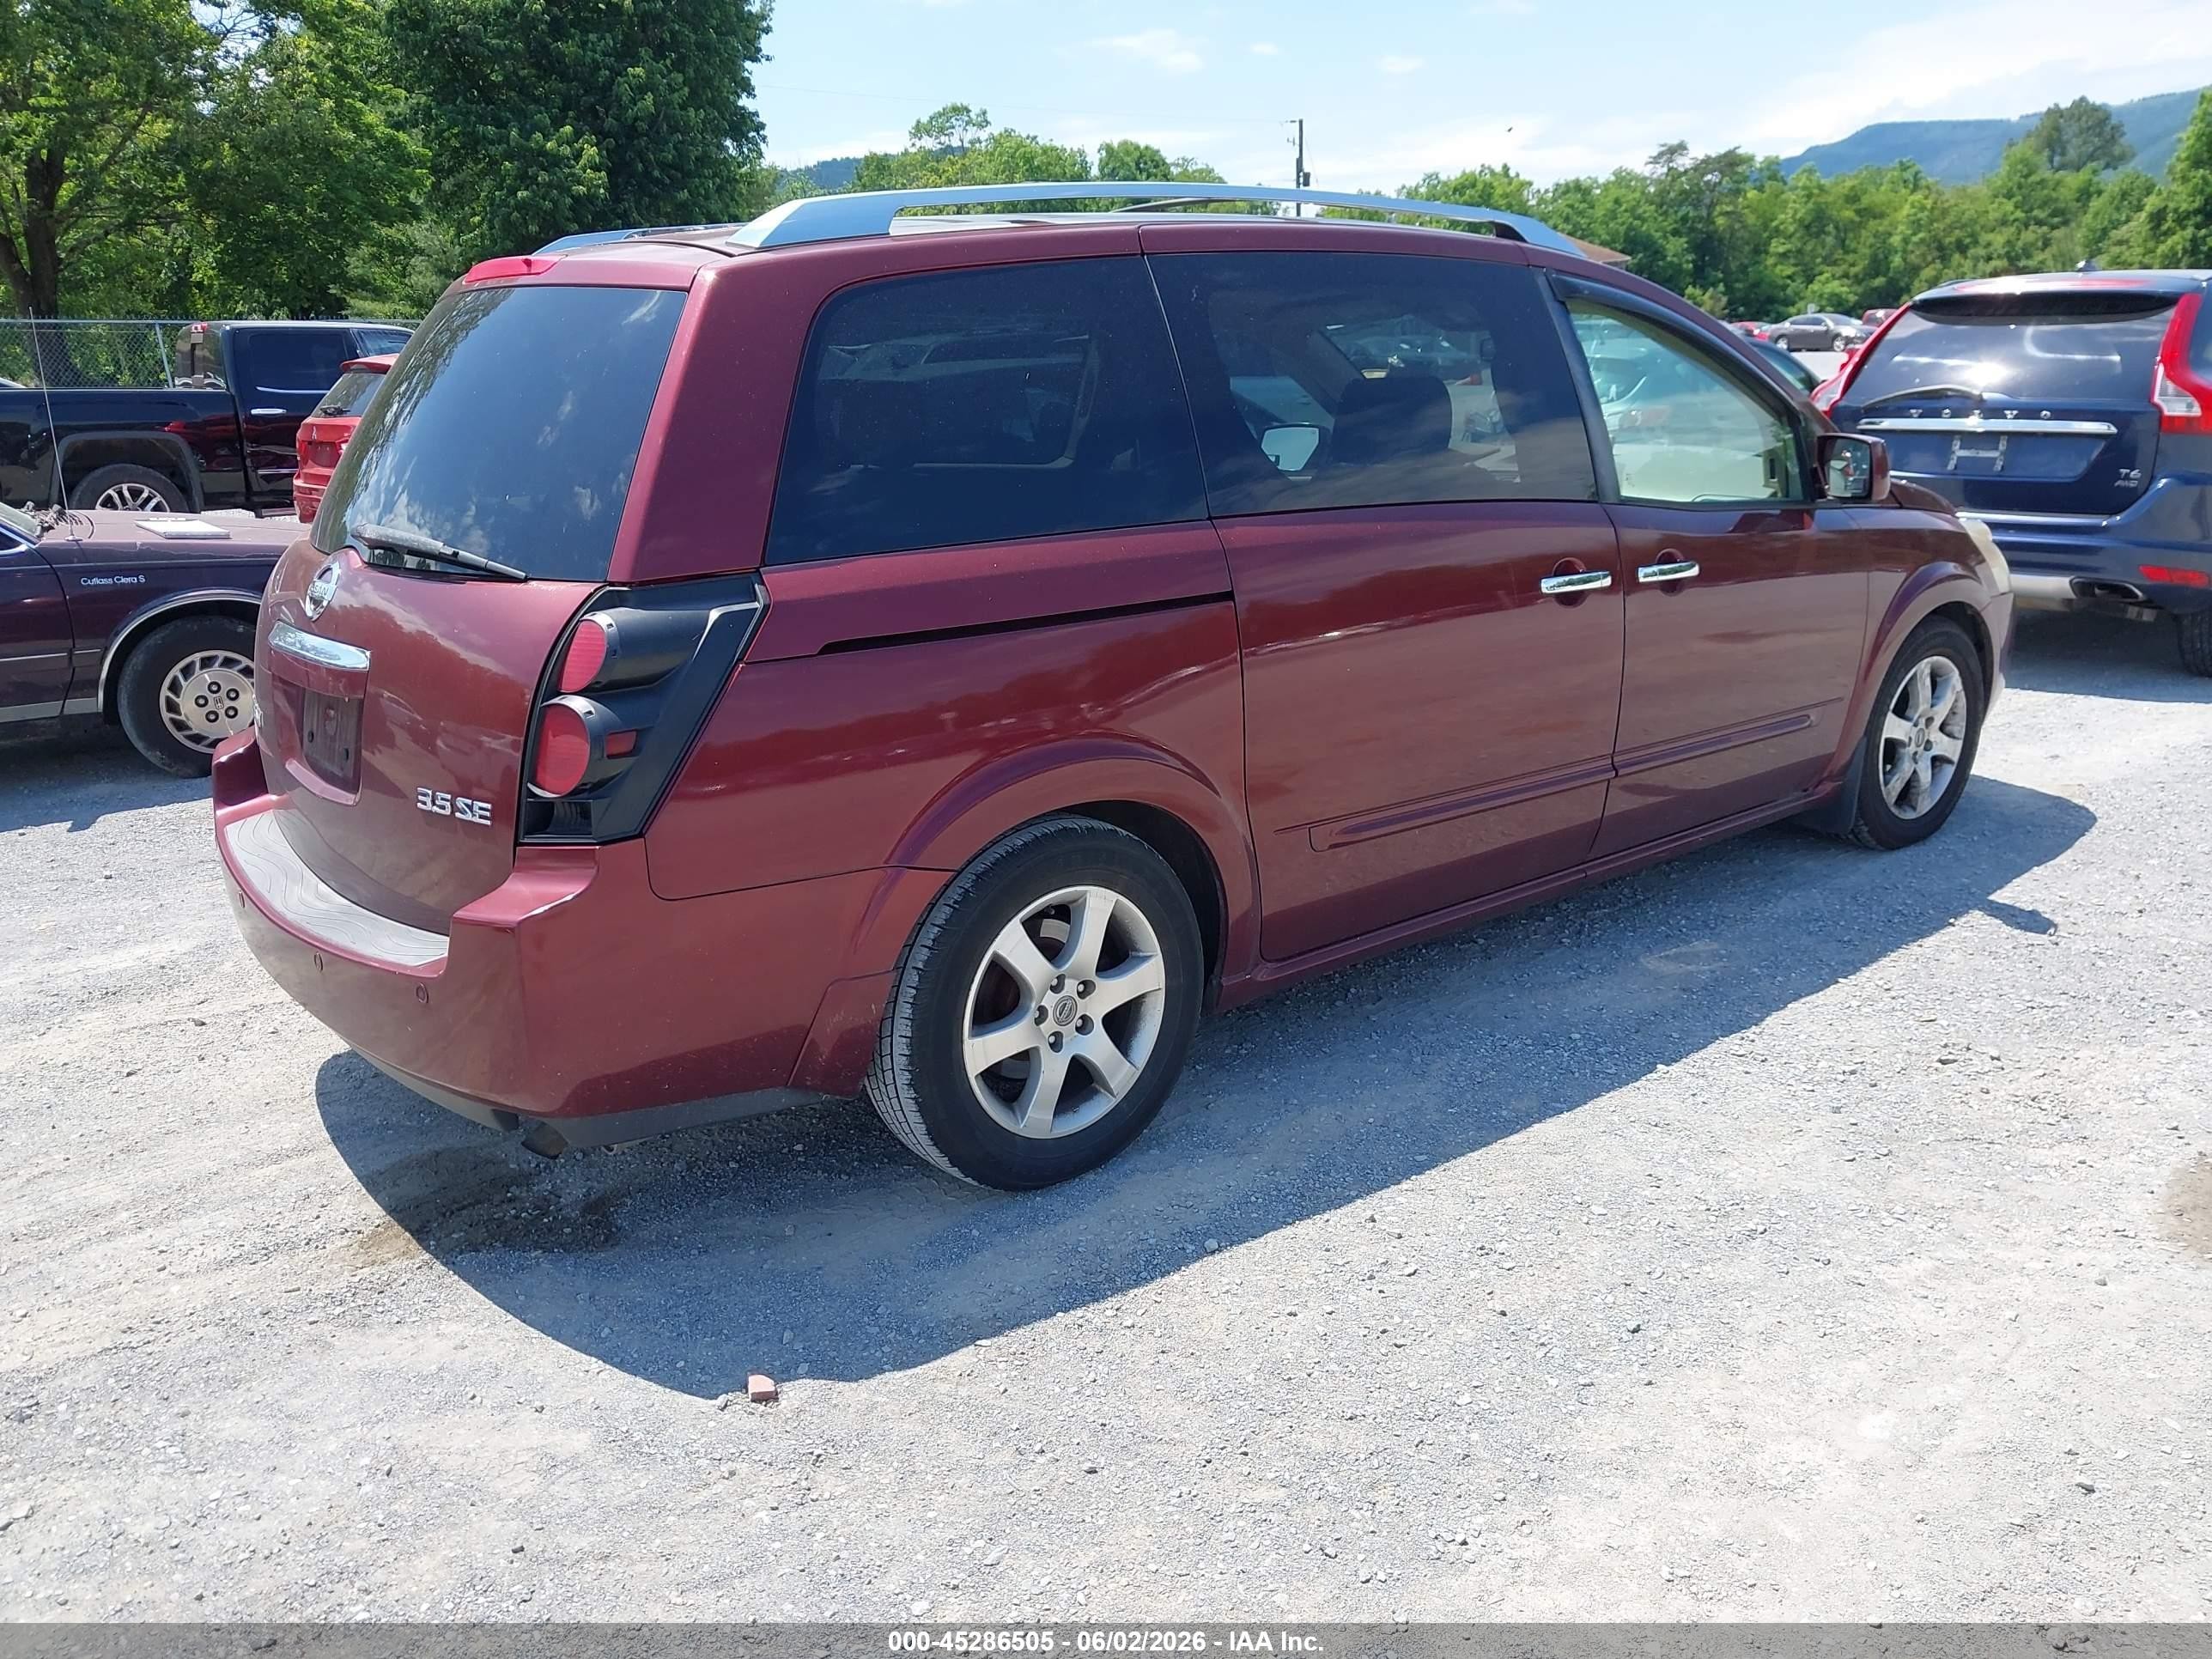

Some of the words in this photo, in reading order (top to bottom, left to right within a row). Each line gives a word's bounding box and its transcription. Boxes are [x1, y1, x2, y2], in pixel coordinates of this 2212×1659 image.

[1909, 408, 2051, 419] VOLVO
[2118, 468, 2142, 479] T6
[113, 575, 137, 584] Ciera
[138, 574, 146, 583] S
[454, 797, 492, 825] SE
